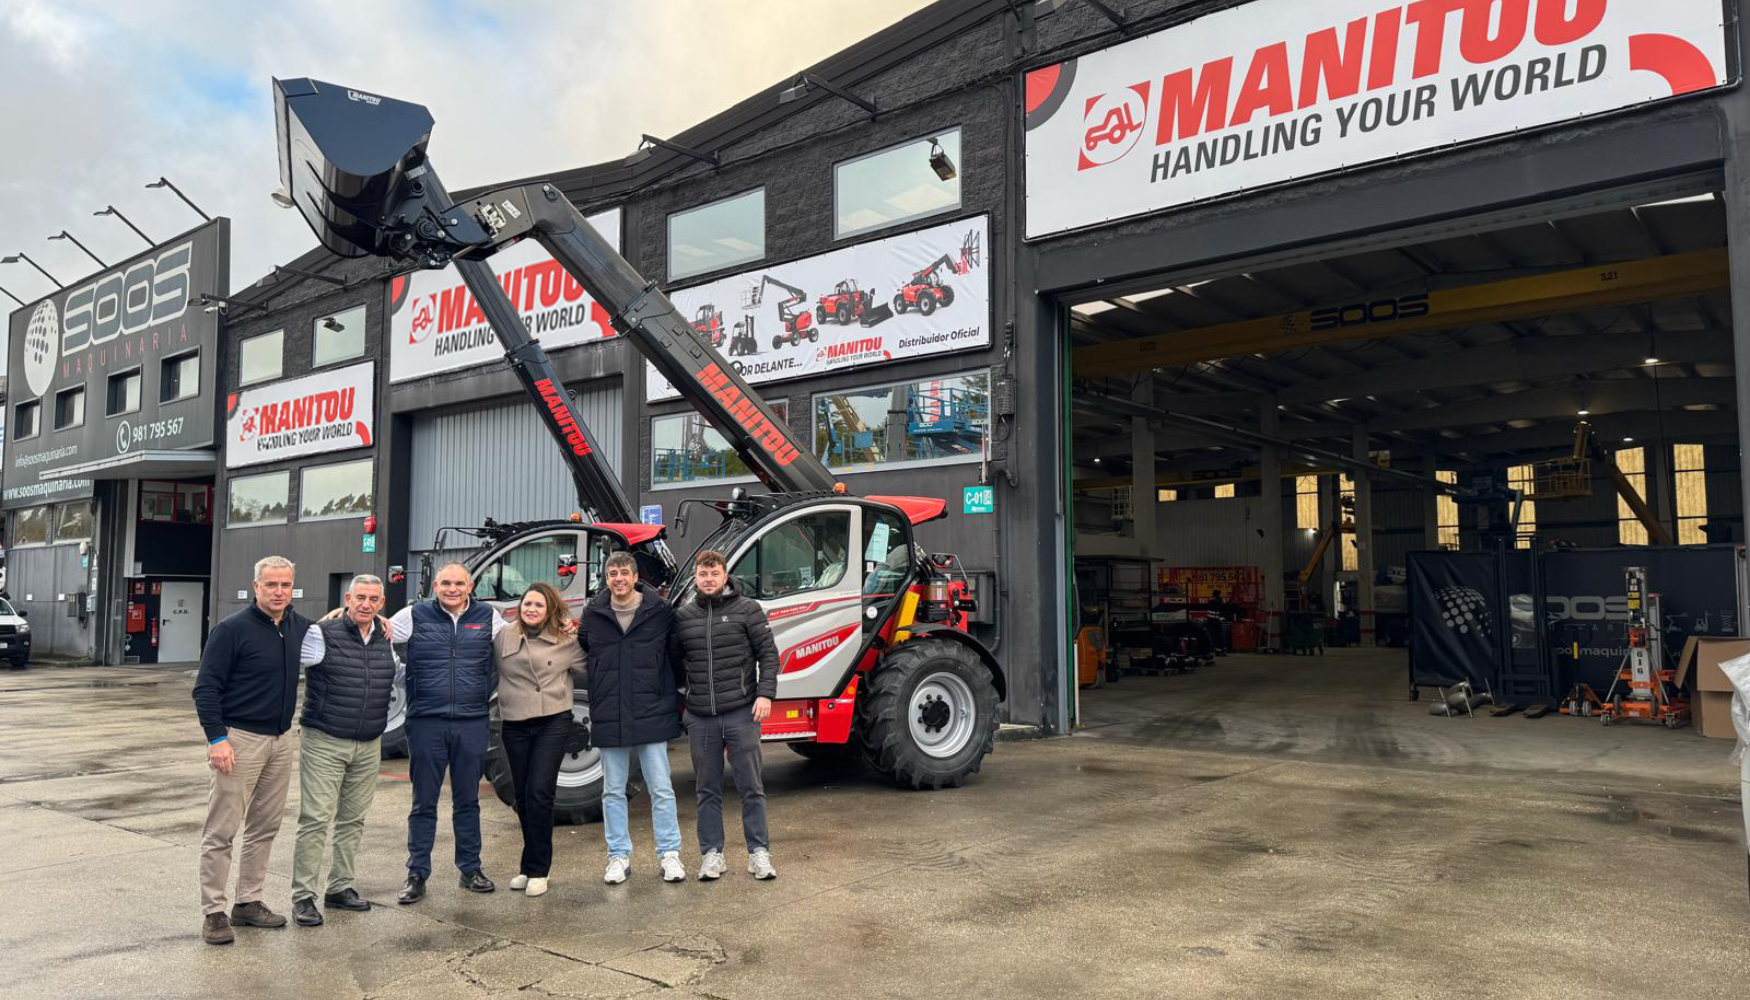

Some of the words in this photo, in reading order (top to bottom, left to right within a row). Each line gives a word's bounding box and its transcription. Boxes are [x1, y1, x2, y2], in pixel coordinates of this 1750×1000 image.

[1155, 0, 1608, 146] MANITOU
[1150, 113, 1322, 183] HANDLING
[1335, 84, 1437, 138] YOUR
[1450, 43, 1607, 111] WORLD
[62, 240, 193, 357] SOOS
[1310, 294, 1429, 331] SOOS
[63, 323, 187, 378] MAQUINARIA
[434, 326, 494, 357] HANDLING
[536, 304, 586, 334] WORLD
[827, 336, 882, 358] MANITOU
[899, 331, 949, 348] Distribuidor
[950, 326, 980, 340] Oficial
[754, 357, 803, 375] DELANTE...
[863, 350, 881, 360] WORLD
[132, 424, 148, 443] 981
[149, 421, 165, 439] 795
[167, 417, 184, 436] 567
[259, 387, 355, 437] MANITOU
[299, 427, 321, 444] YOUR
[322, 422, 352, 440] WORLD
[534, 378, 592, 457] MANITOU
[695, 362, 800, 467] MANITOU
[795, 635, 840, 659] MANITOU
